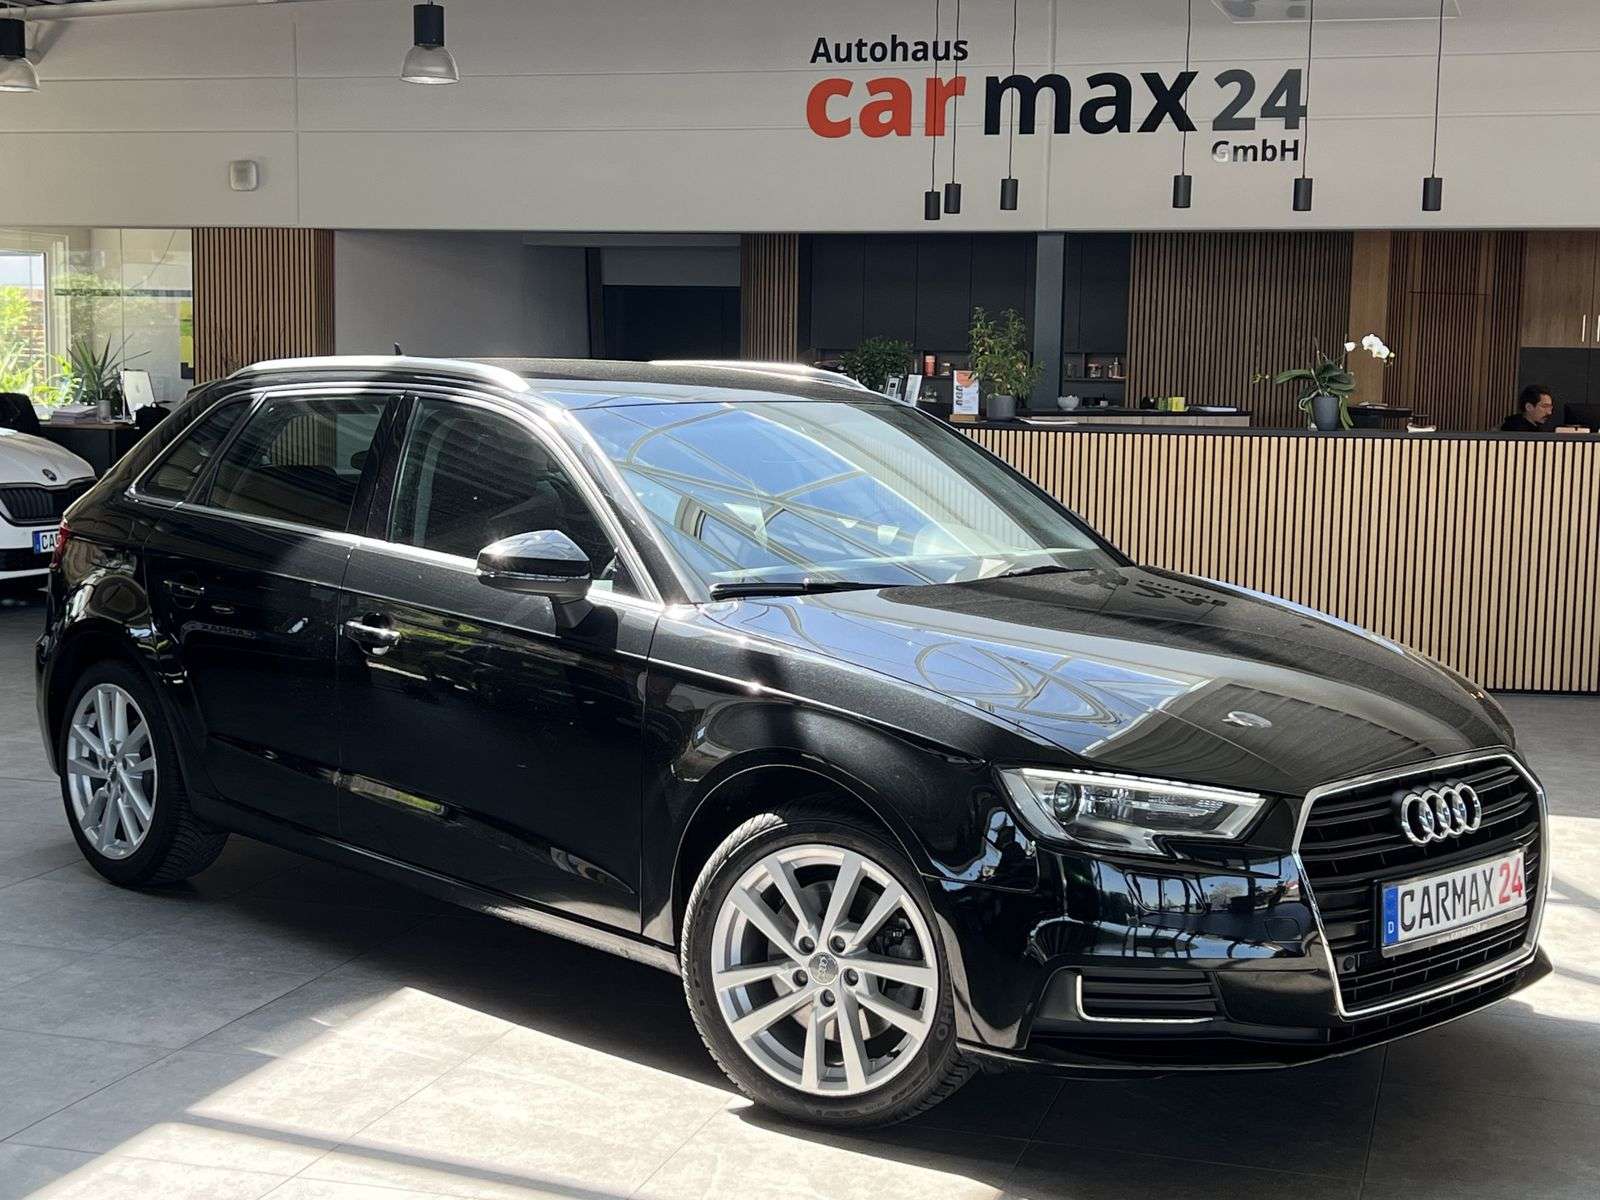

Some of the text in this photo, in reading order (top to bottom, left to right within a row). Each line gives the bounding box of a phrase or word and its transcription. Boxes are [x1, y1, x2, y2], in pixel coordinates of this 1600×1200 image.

[810, 34, 969, 63] Autohaus
[1211, 139, 1299, 162] GmbH
[1387, 920, 1395, 934] D
